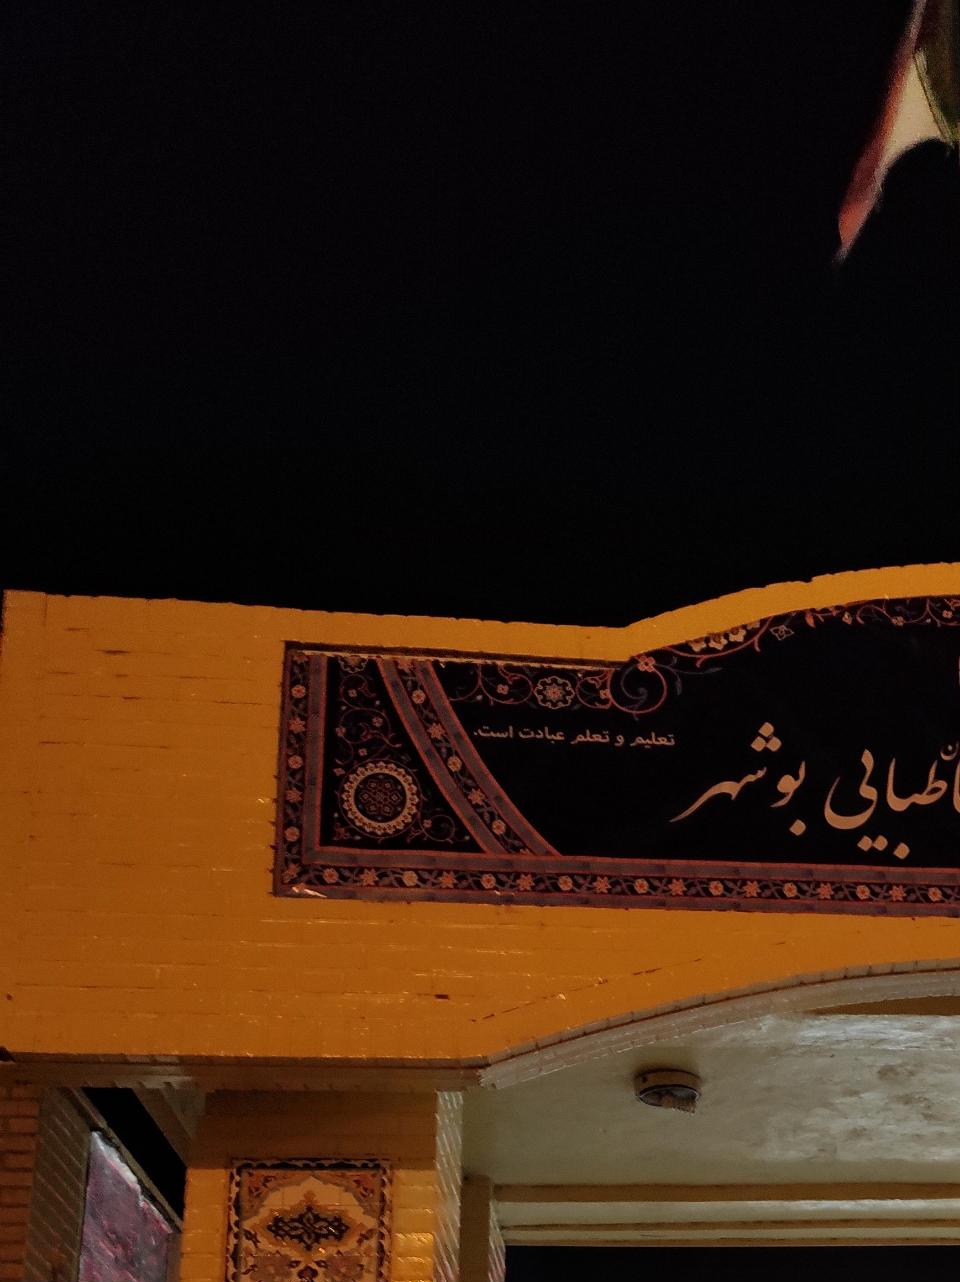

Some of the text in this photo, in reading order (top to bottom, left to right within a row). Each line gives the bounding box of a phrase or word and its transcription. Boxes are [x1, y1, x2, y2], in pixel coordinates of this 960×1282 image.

[518, 727, 565, 744] عبادت
[570, 729, 610, 745] تعلم
[614, 735, 625, 747] و
[630, 732, 675, 749] تعلیم
[669, 721, 807, 836] بوشهر
